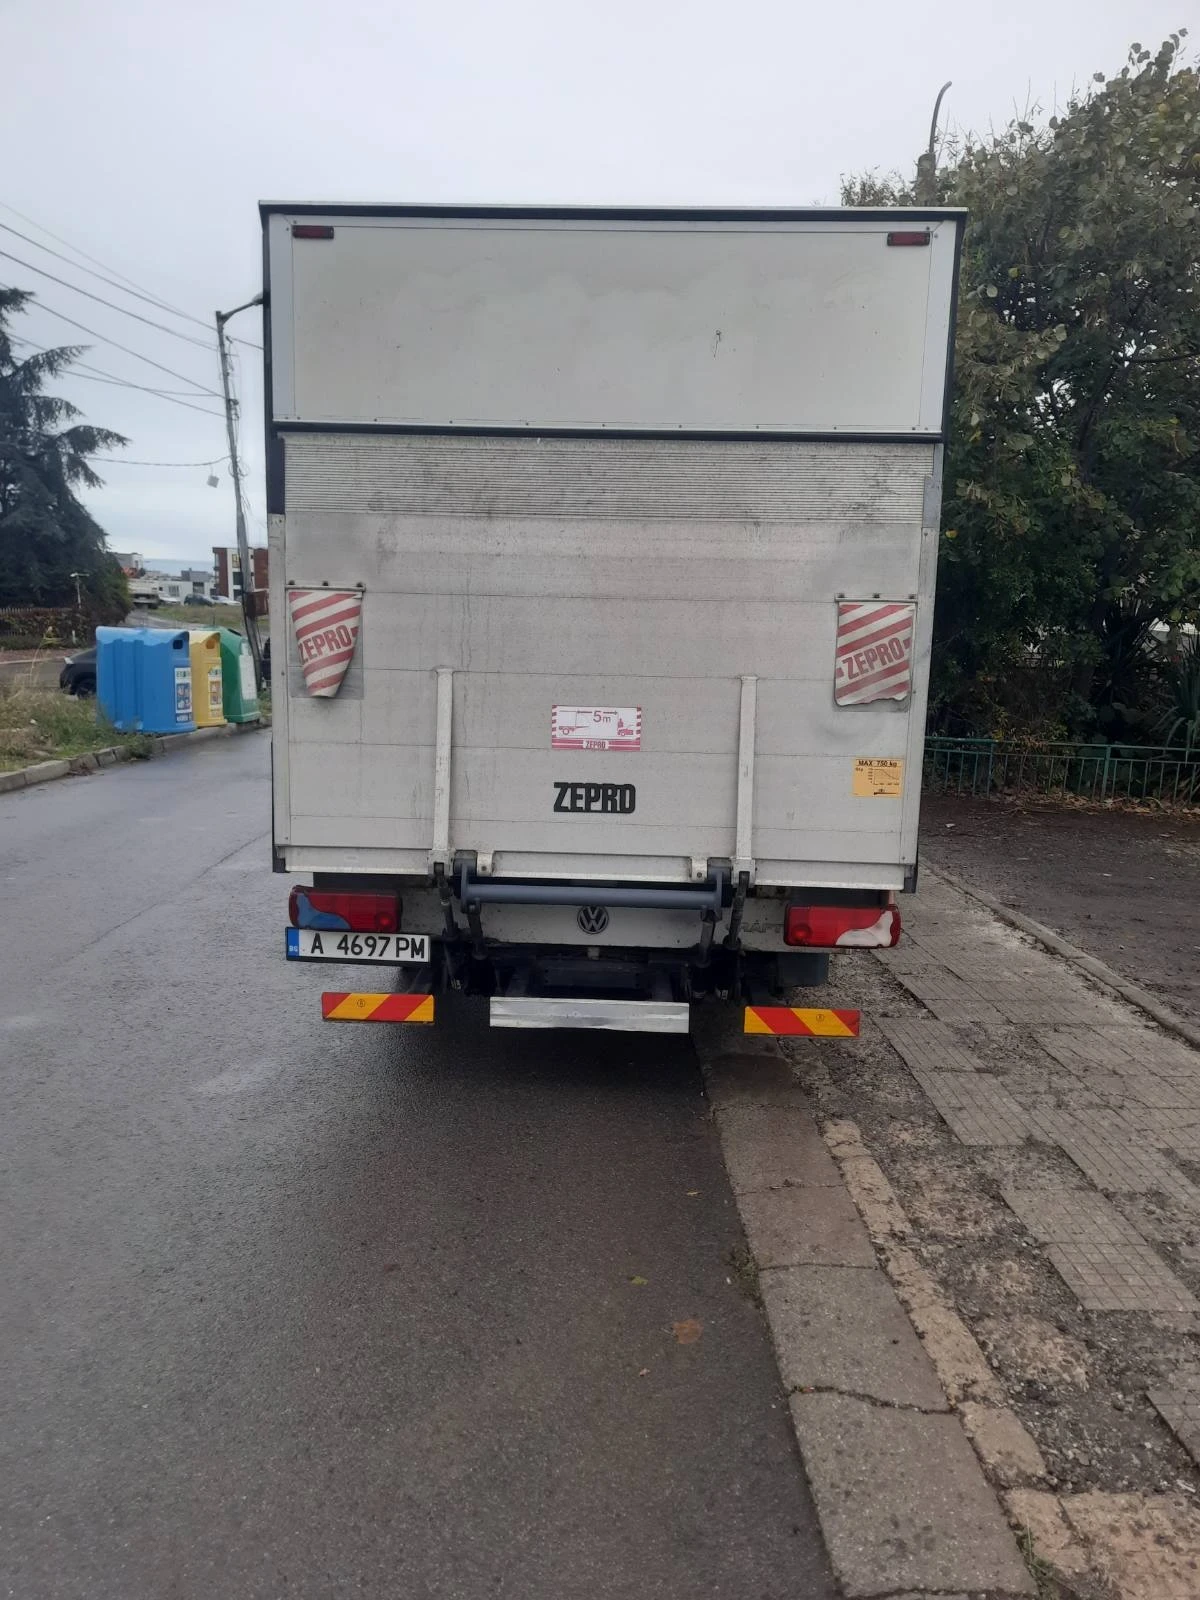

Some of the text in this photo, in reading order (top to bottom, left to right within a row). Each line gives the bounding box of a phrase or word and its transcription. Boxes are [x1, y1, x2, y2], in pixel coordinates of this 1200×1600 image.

[298, 625, 352, 665] ZEPRO
[842, 638, 905, 680] ZEPRO
[585, 740, 606, 749] ZEPRO
[553, 782, 636, 814] ZEPRO
[310, 933, 324, 954] A
[336, 934, 391, 957] 4697
